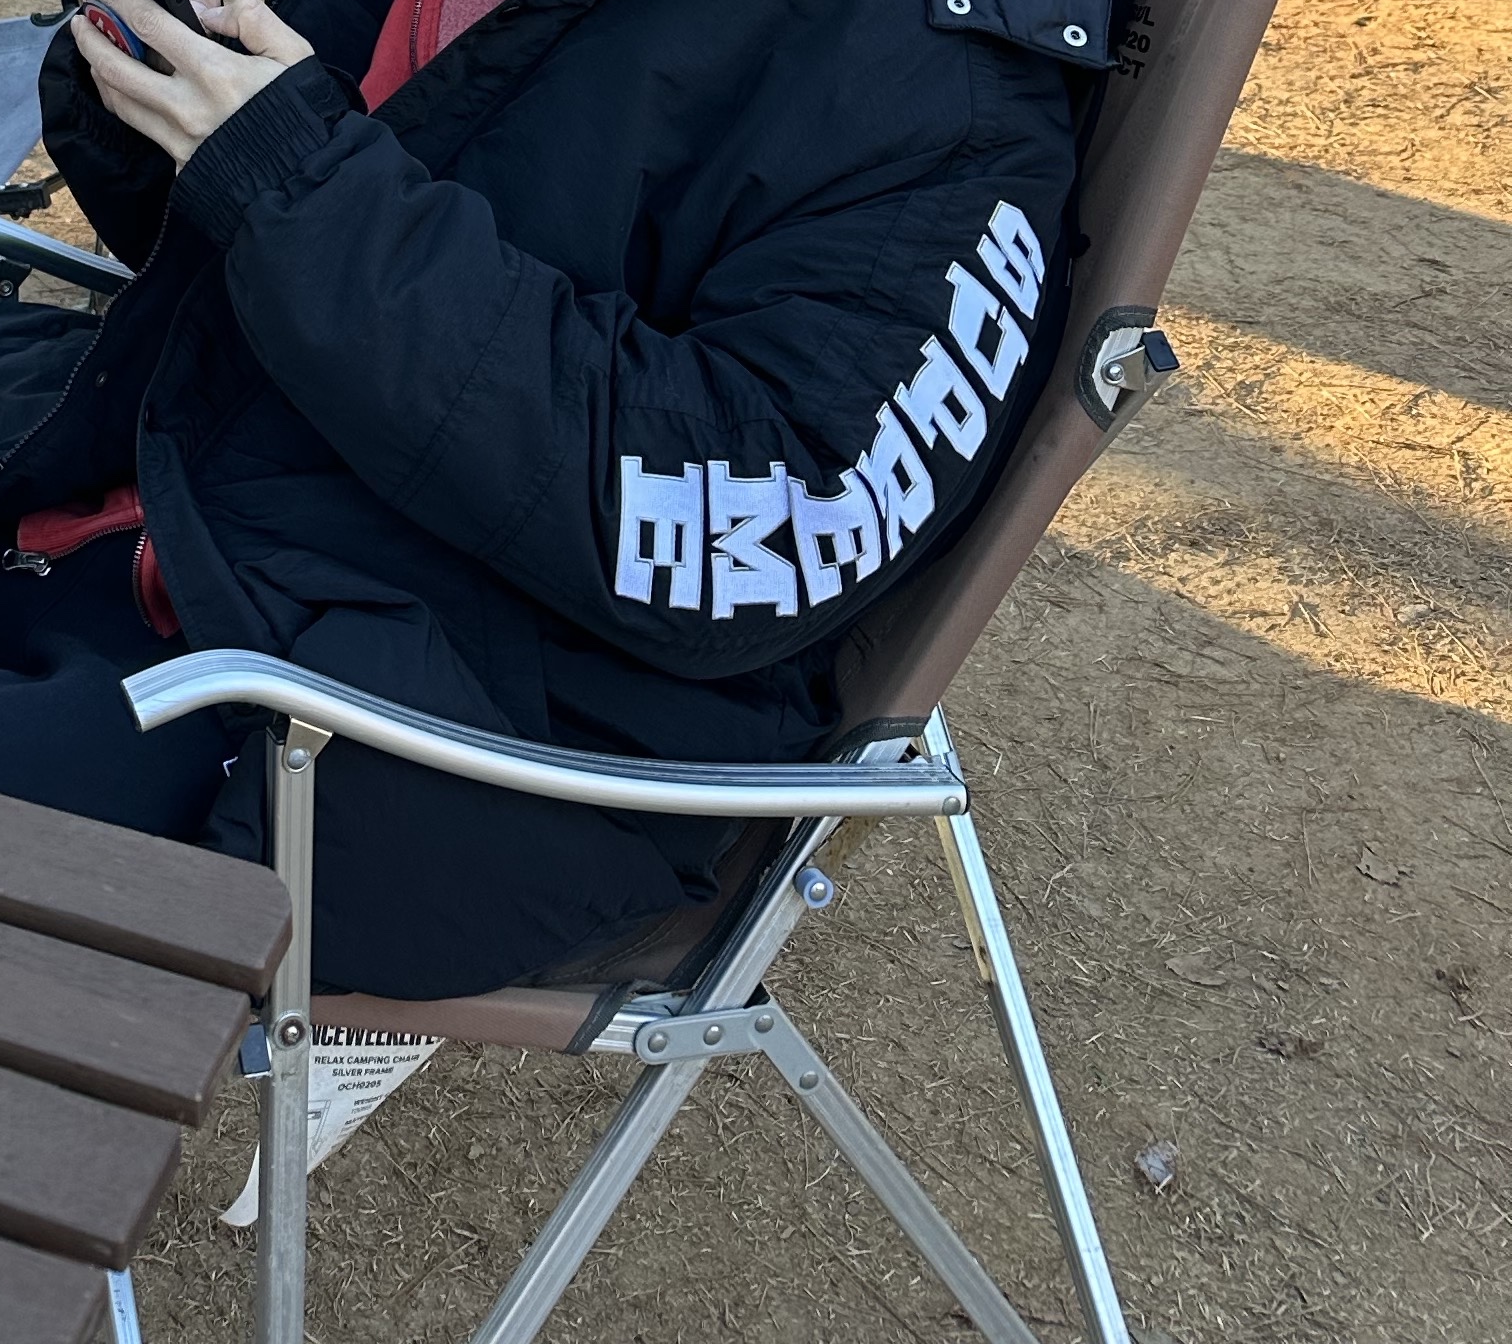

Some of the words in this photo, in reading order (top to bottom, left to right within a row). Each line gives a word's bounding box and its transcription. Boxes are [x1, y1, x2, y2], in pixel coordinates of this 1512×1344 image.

[314, 1055, 345, 1065] RELAX
[347, 1055, 390, 1065] CAMPING
[331, 1067, 363, 1077] SILVER
